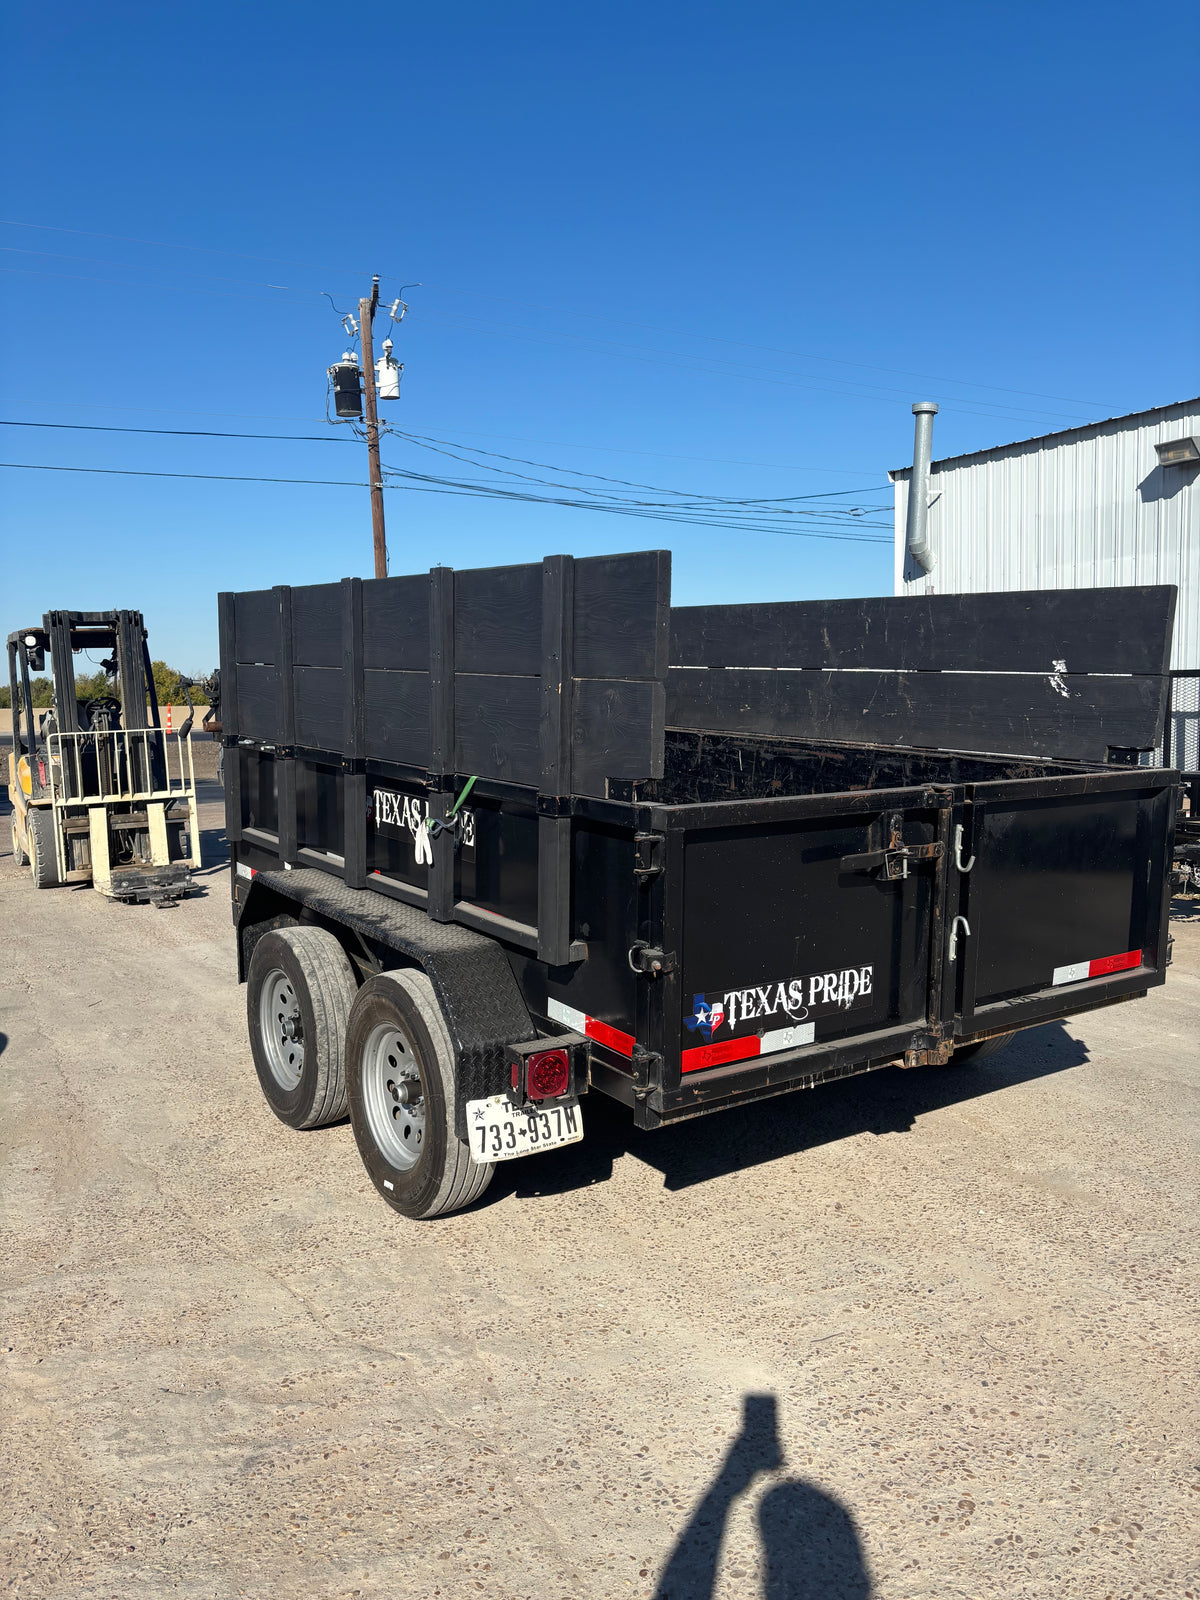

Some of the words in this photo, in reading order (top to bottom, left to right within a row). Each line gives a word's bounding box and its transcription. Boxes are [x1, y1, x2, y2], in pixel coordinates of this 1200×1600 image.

[374, 789, 422, 840] TEXAS
[724, 980, 809, 1030] TEXAS
[807, 966, 873, 1009] PRIDE
[515, 1147, 530, 1156] Lone
[542, 1140, 558, 1148] State
